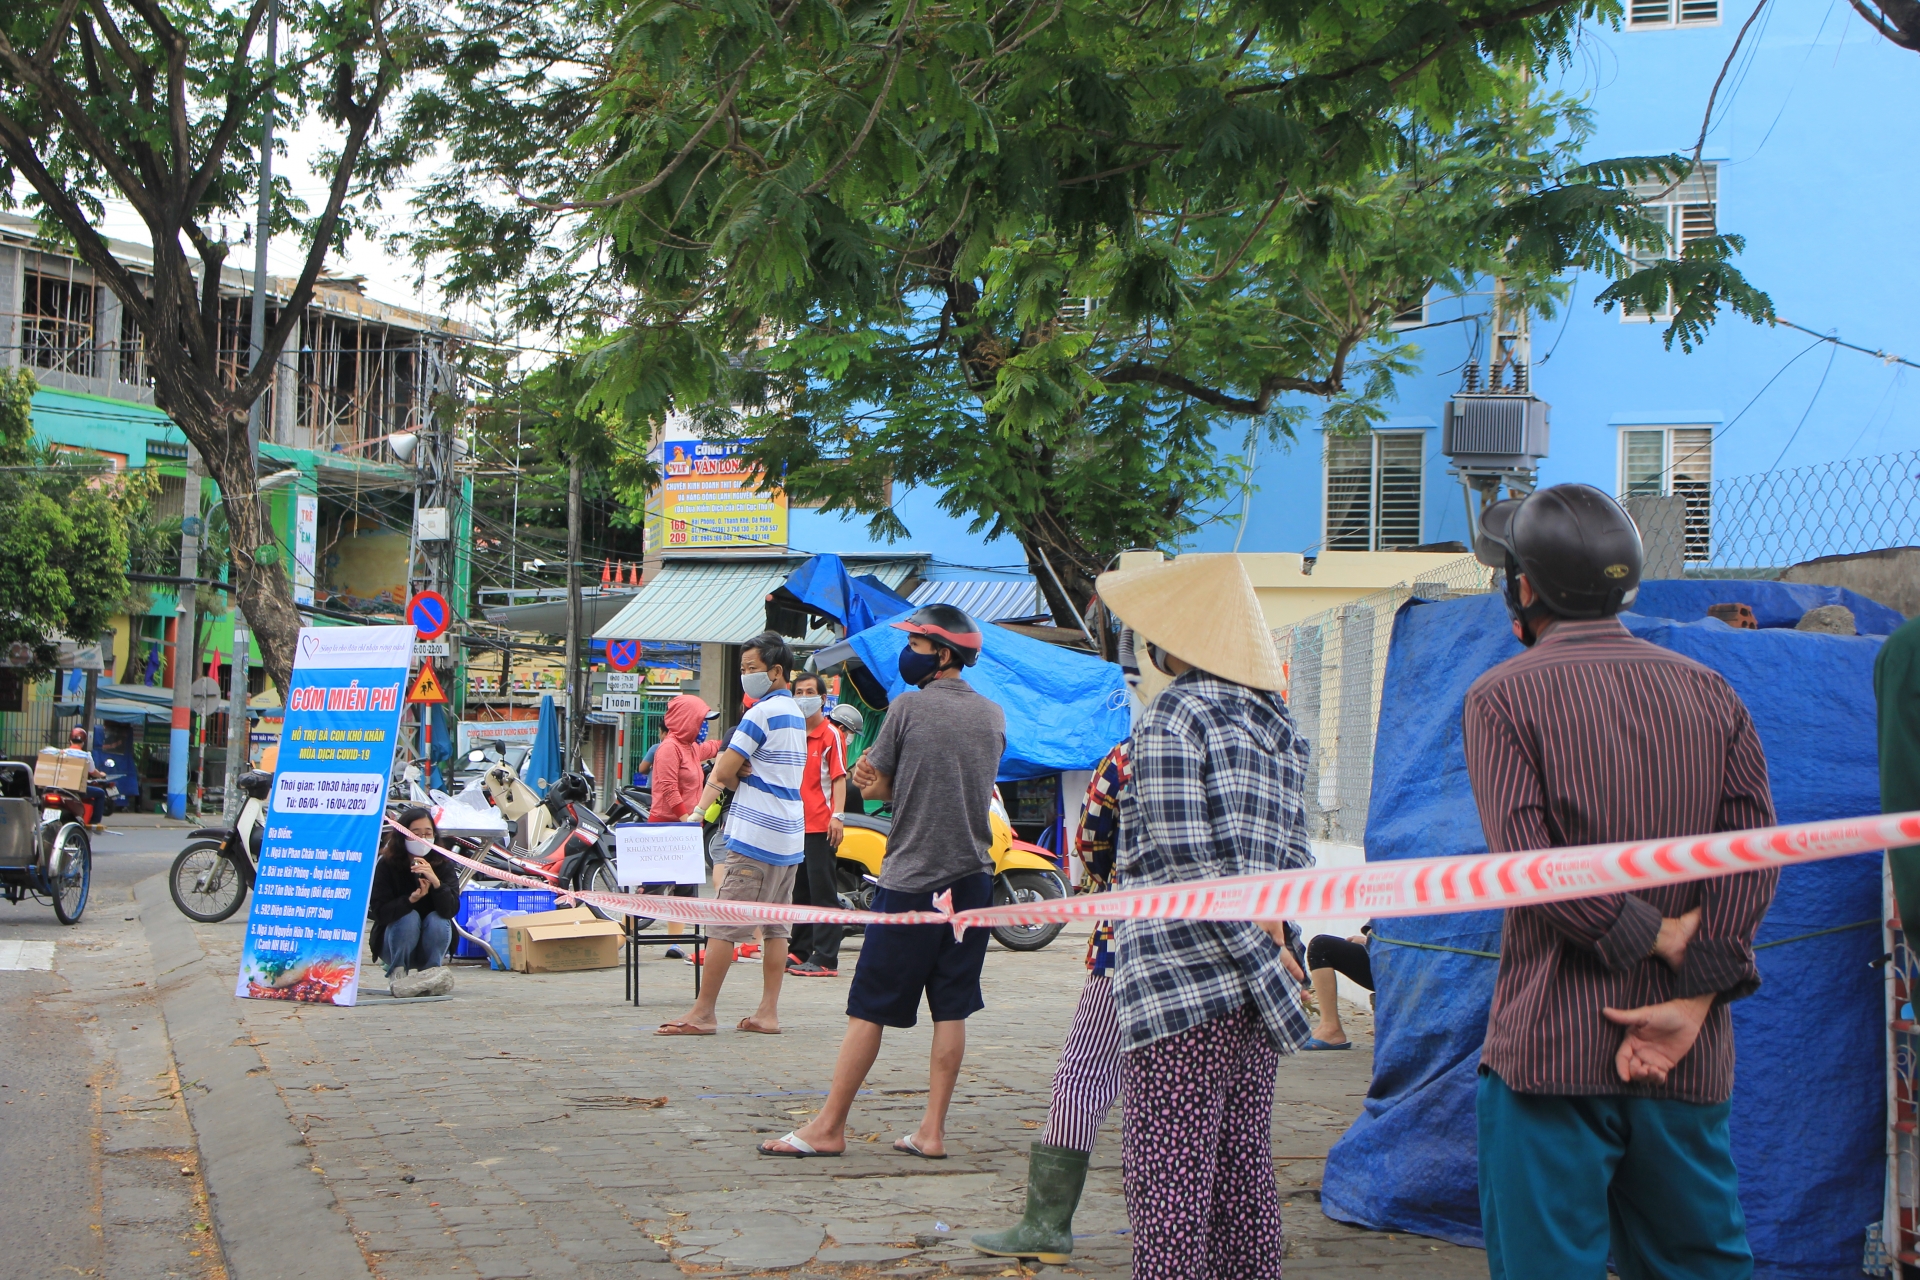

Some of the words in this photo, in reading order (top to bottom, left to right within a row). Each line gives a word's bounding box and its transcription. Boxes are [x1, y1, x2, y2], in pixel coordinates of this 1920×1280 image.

[671, 464, 686, 472] VLT
[670, 533, 686, 543] 209
[291, 686, 326, 710] CƠM
[327, 680, 368, 711] MIỄN
[369, 683, 400, 711] PHÍ
[330, 730, 346, 741] CON
[317, 748, 335, 762] DỊCH
[336, 749, 370, 760] COVID-19
[280, 779, 295, 791] Thời
[297, 781, 315, 792] gian:
[318, 780, 339, 792] 10h30
[360, 781, 379, 794] ngày
[298, 797, 318, 808] 06/04
[326, 798, 366, 810] 16/04/2020
[268, 827, 278, 840] Địa
[288, 848, 300, 859] Phan
[264, 884, 274, 895] 512
[306, 906, 318, 918] (FPT
[318, 908, 333, 920] Shop)
